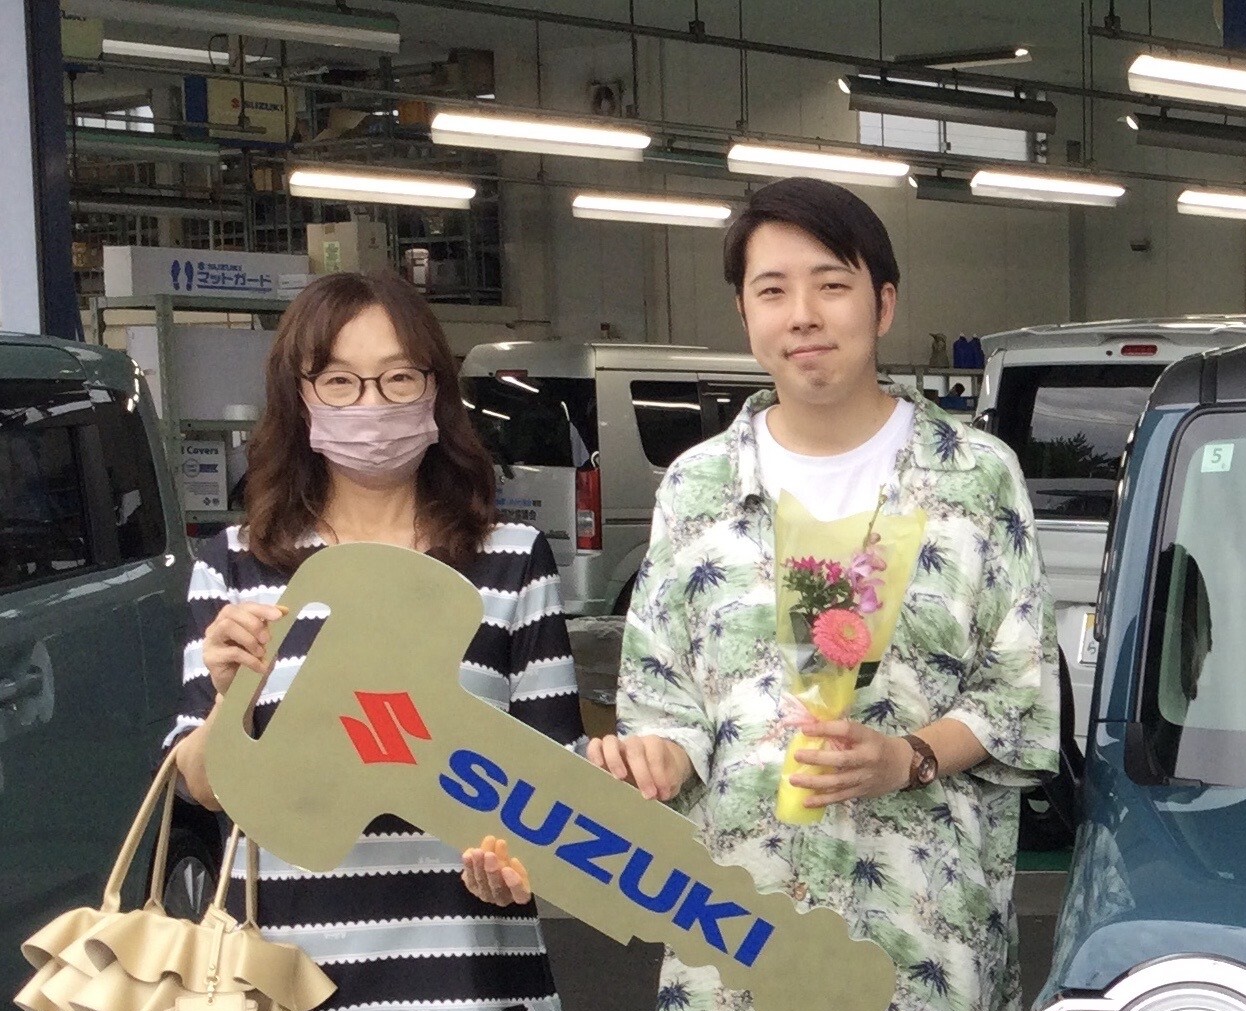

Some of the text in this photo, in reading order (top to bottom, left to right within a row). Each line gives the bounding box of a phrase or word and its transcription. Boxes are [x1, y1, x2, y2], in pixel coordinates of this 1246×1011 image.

[197, 271, 272, 287] マットガード
[186, 445, 219, 455] Covers
[1211, 447, 1223, 464] 5
[438, 748, 775, 968] SUZUKI
